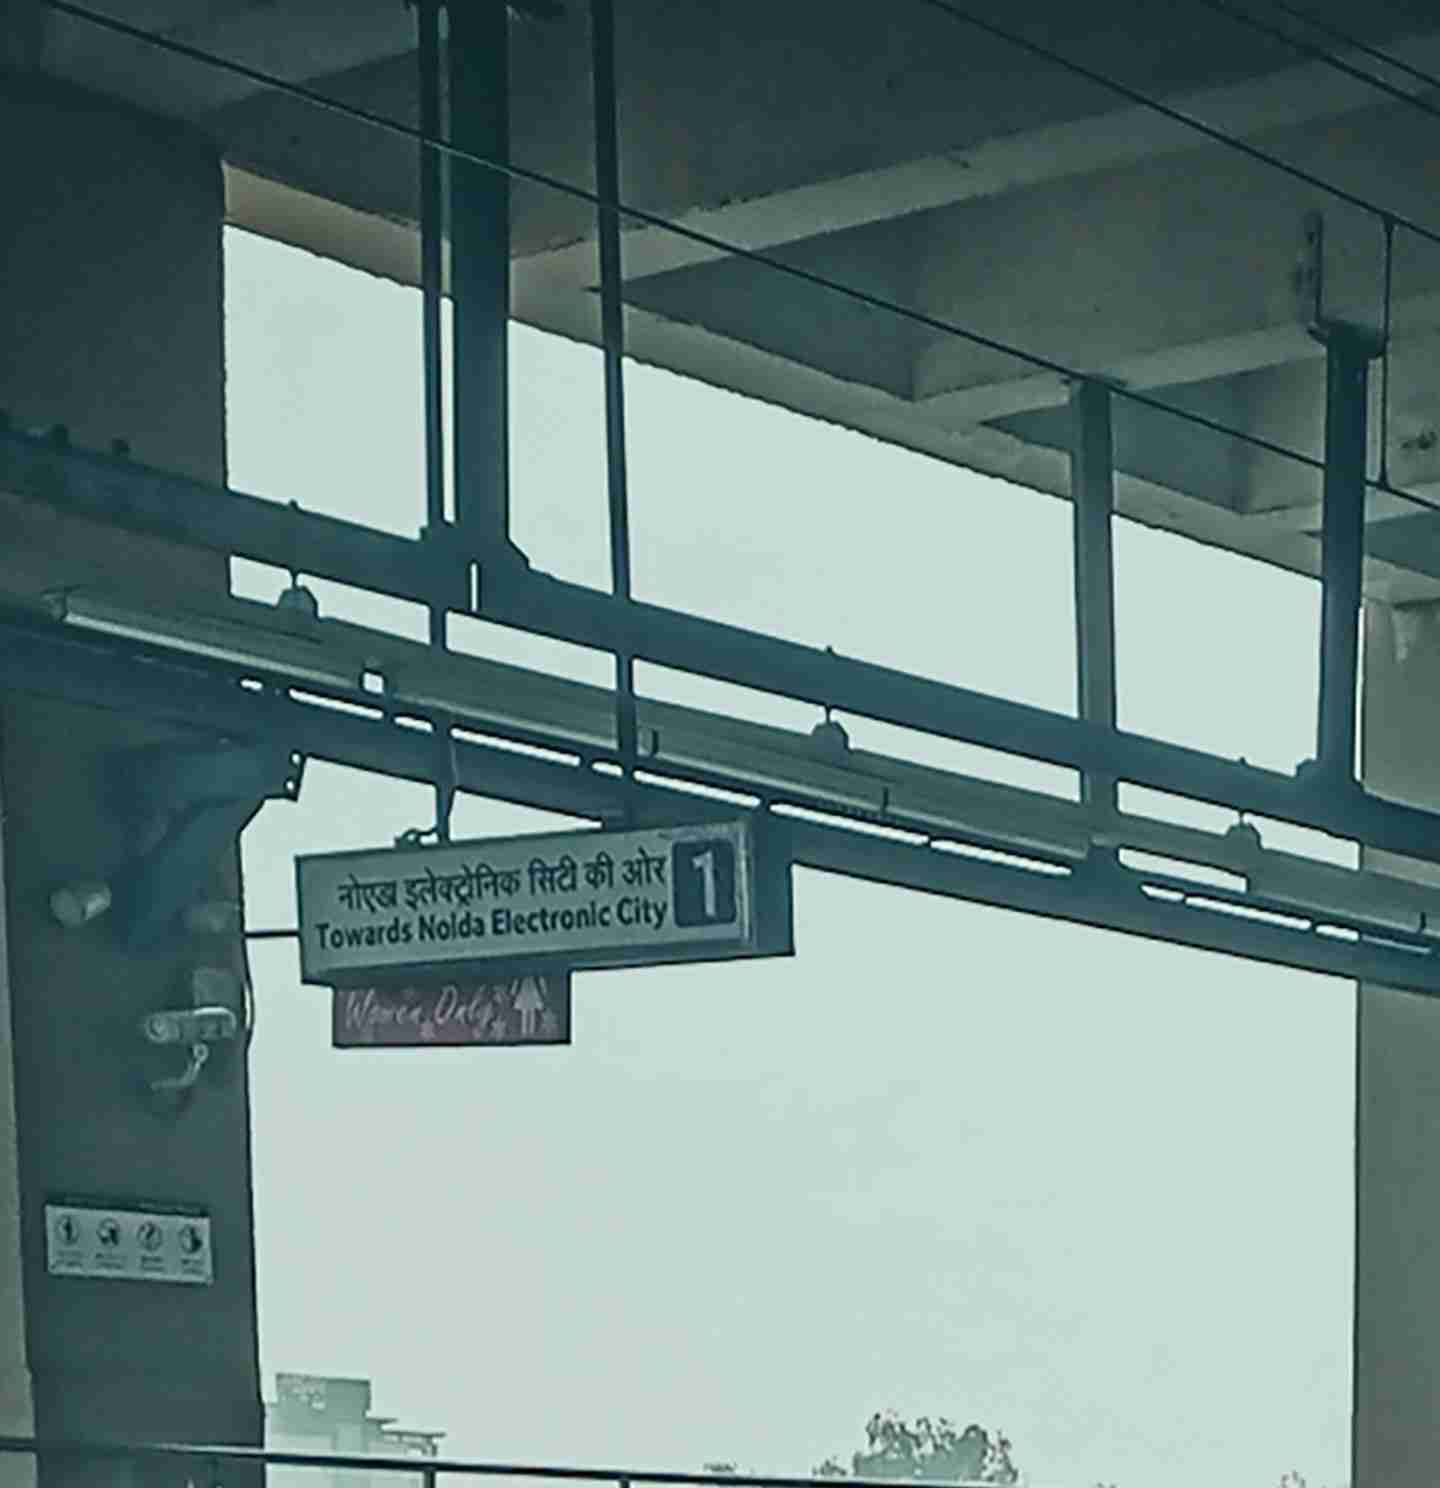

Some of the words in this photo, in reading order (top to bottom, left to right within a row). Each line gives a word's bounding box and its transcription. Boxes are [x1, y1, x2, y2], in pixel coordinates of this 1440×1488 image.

[528, 853, 578, 896] सिटी
[584, 851, 615, 889] की
[622, 848, 668, 887] ओर
[691, 850, 716, 918] 1
[315, 916, 413, 950] Towards
[418, 911, 486, 943] Noida
[491, 901, 612, 936] Electronic
[616, 897, 669, 931] City
[434, 985, 493, 1030] Only
